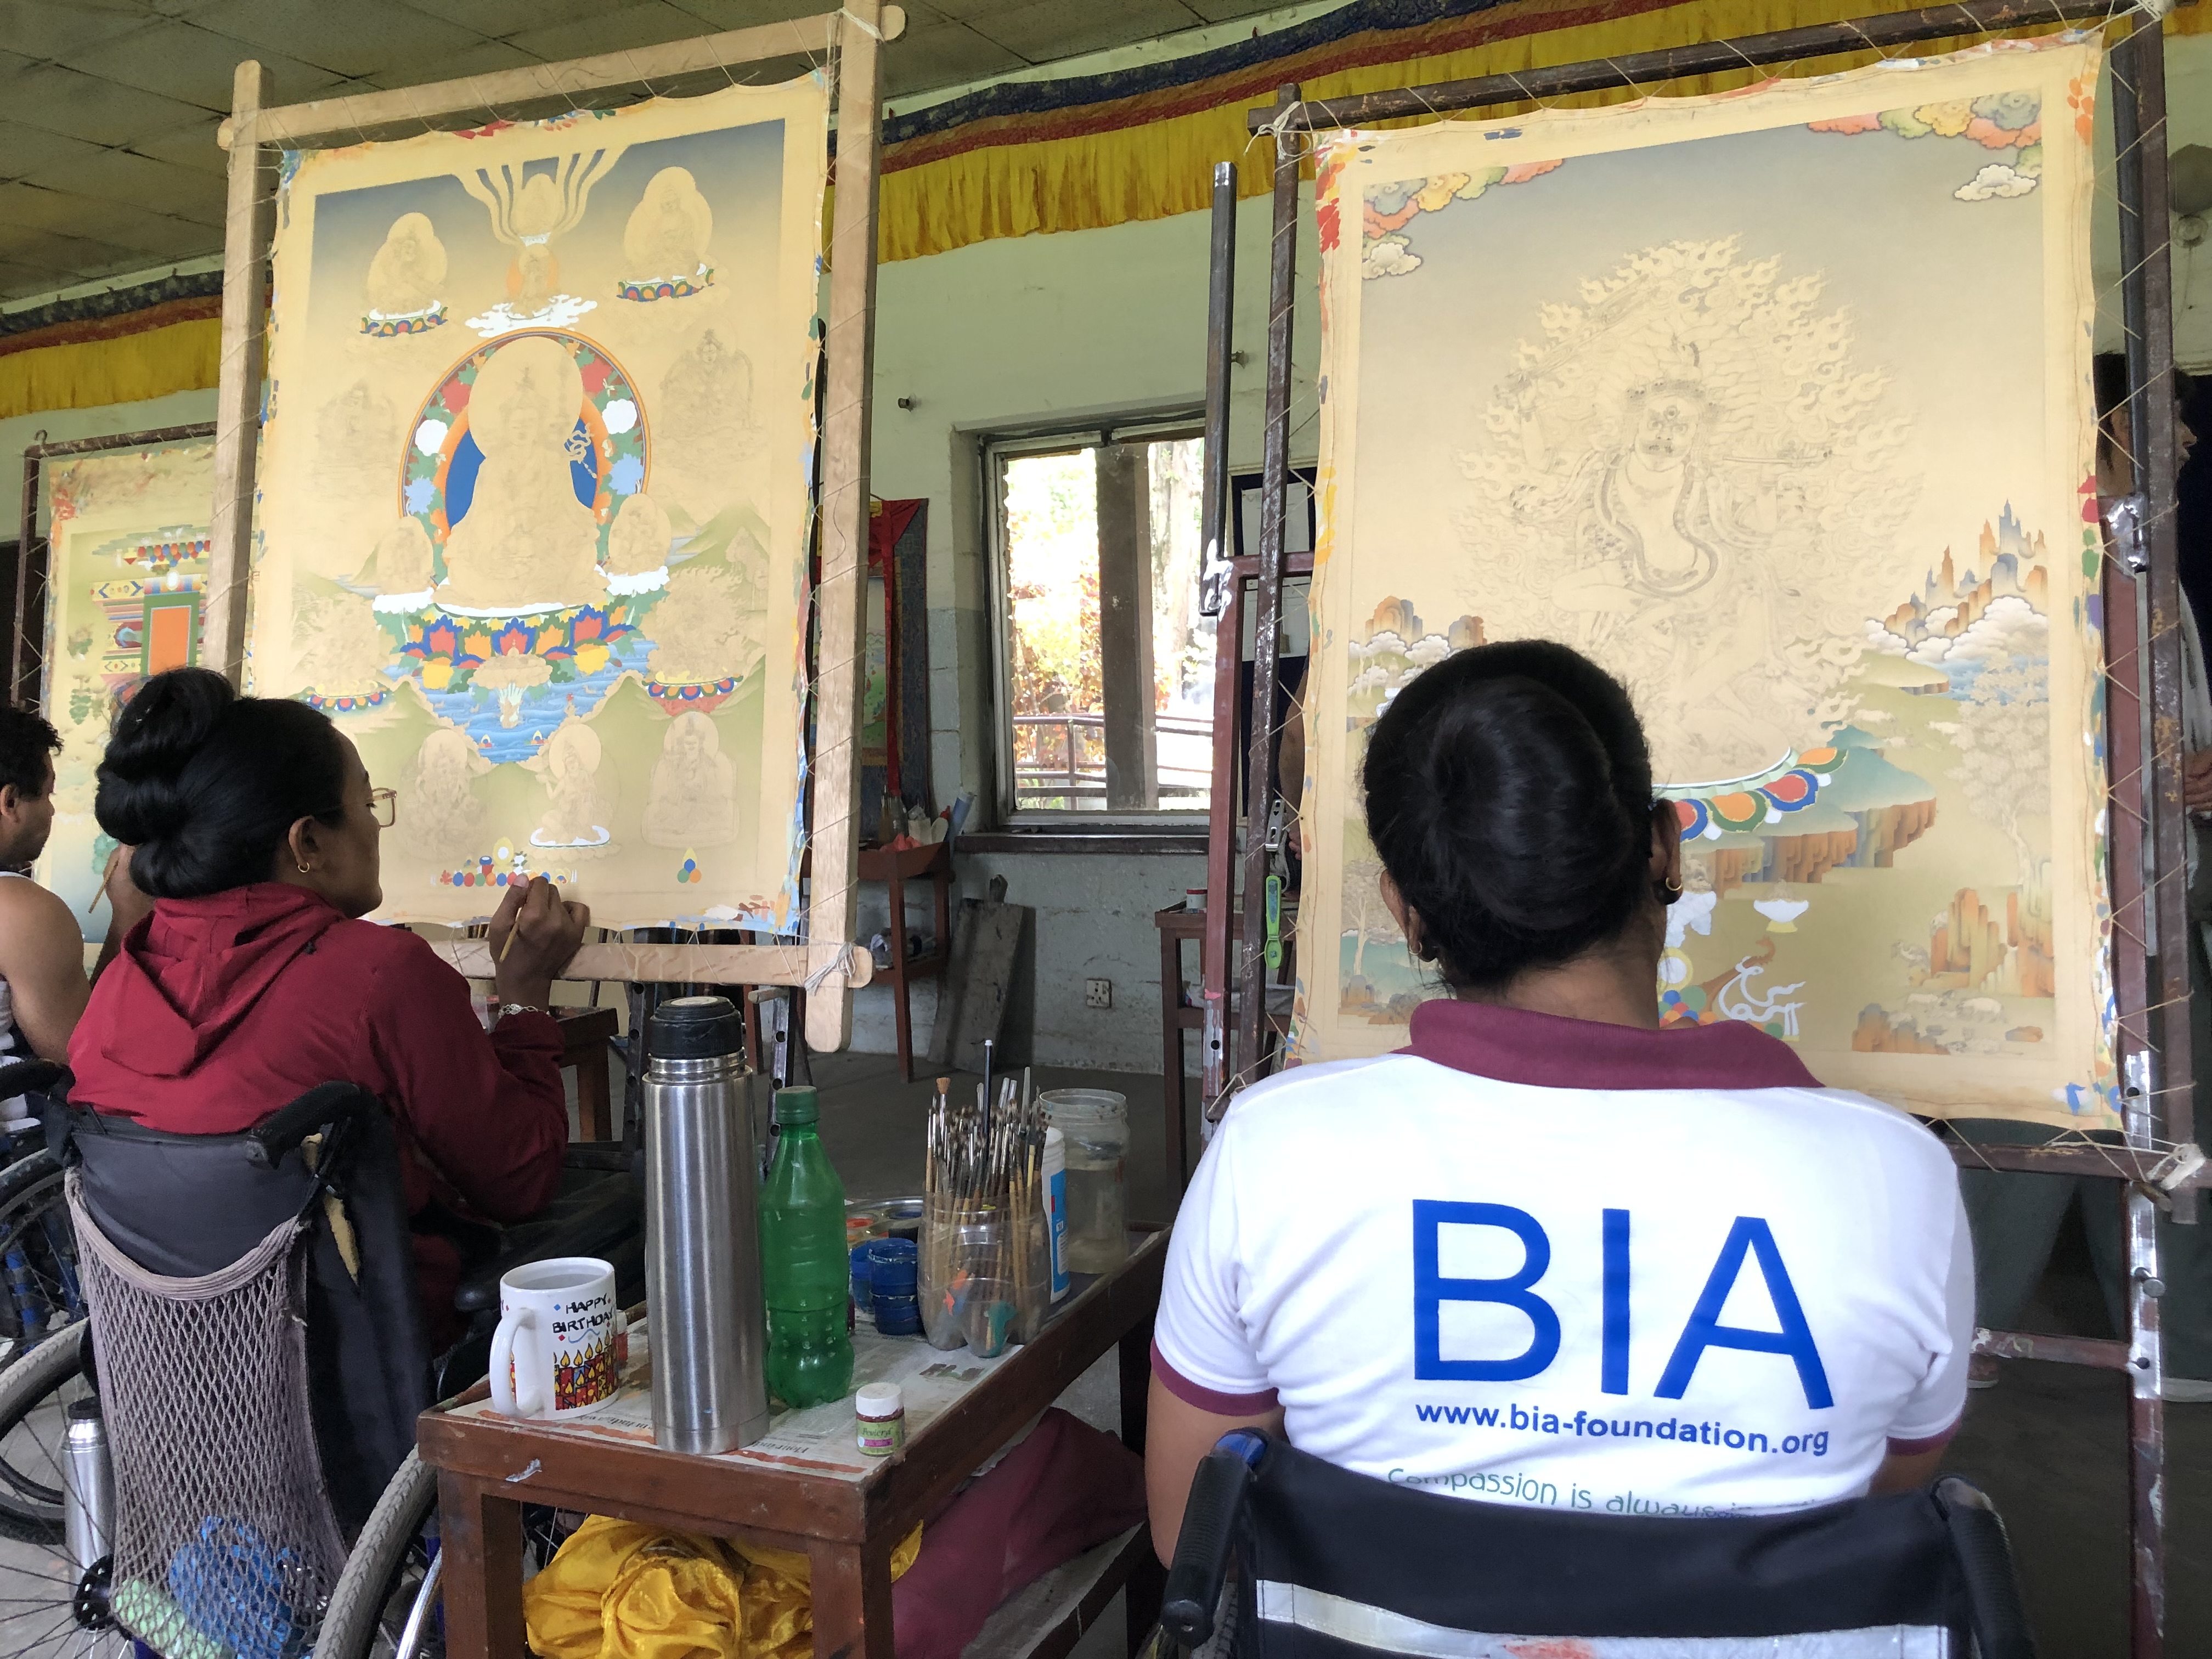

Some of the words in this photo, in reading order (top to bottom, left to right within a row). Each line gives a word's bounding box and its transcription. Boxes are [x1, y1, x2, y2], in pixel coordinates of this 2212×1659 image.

[552, 1306, 613, 1334] BIRTHDAY
[566, 1293, 607, 1314] HAPPY
[1413, 1199, 1836, 1410] BIA
[1415, 1403, 1830, 1458] www.bia-foundation.org
[1387, 1468, 1557, 1506] Compassion
[1571, 1482, 1592, 1509] is
